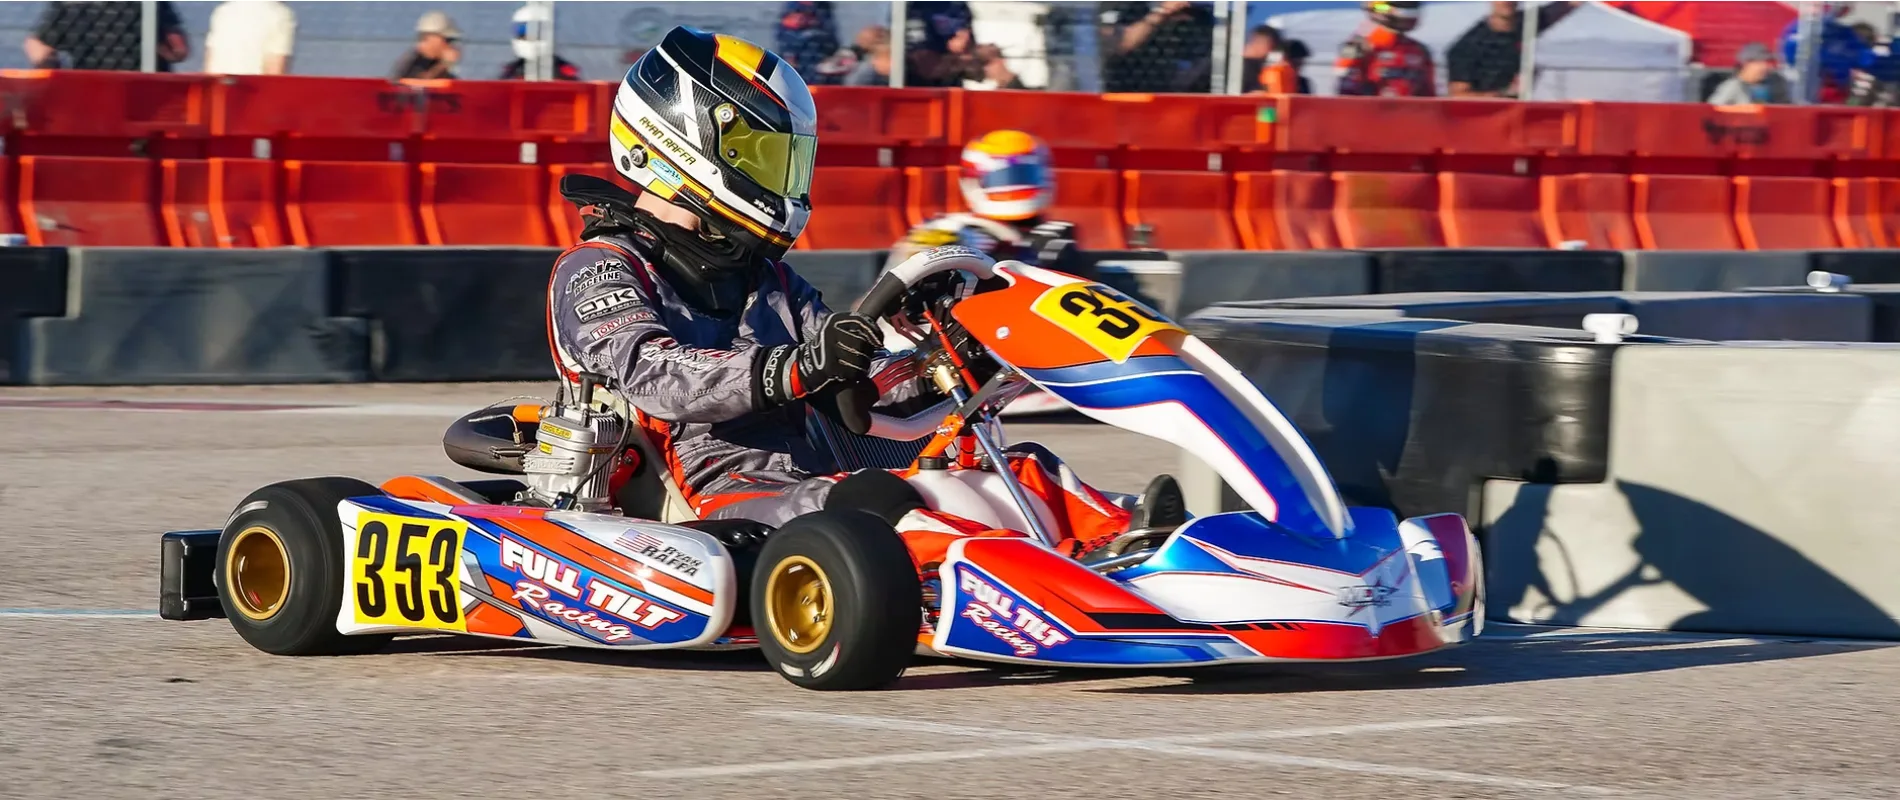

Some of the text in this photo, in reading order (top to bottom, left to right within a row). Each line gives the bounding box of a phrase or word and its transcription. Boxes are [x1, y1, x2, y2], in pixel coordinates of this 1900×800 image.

[638, 116, 697, 166] RYAN RAFFA
[580, 288, 637, 315] OTK
[356, 520, 458, 624] 353
[500, 535, 687, 630] FULL TILT
[640, 545, 699, 577] RAFFA
[664, 546, 702, 567] RYAN
[512, 580, 632, 641] Racing
[960, 566, 1071, 649] FULL TILT
[961, 601, 1038, 656] Racing
